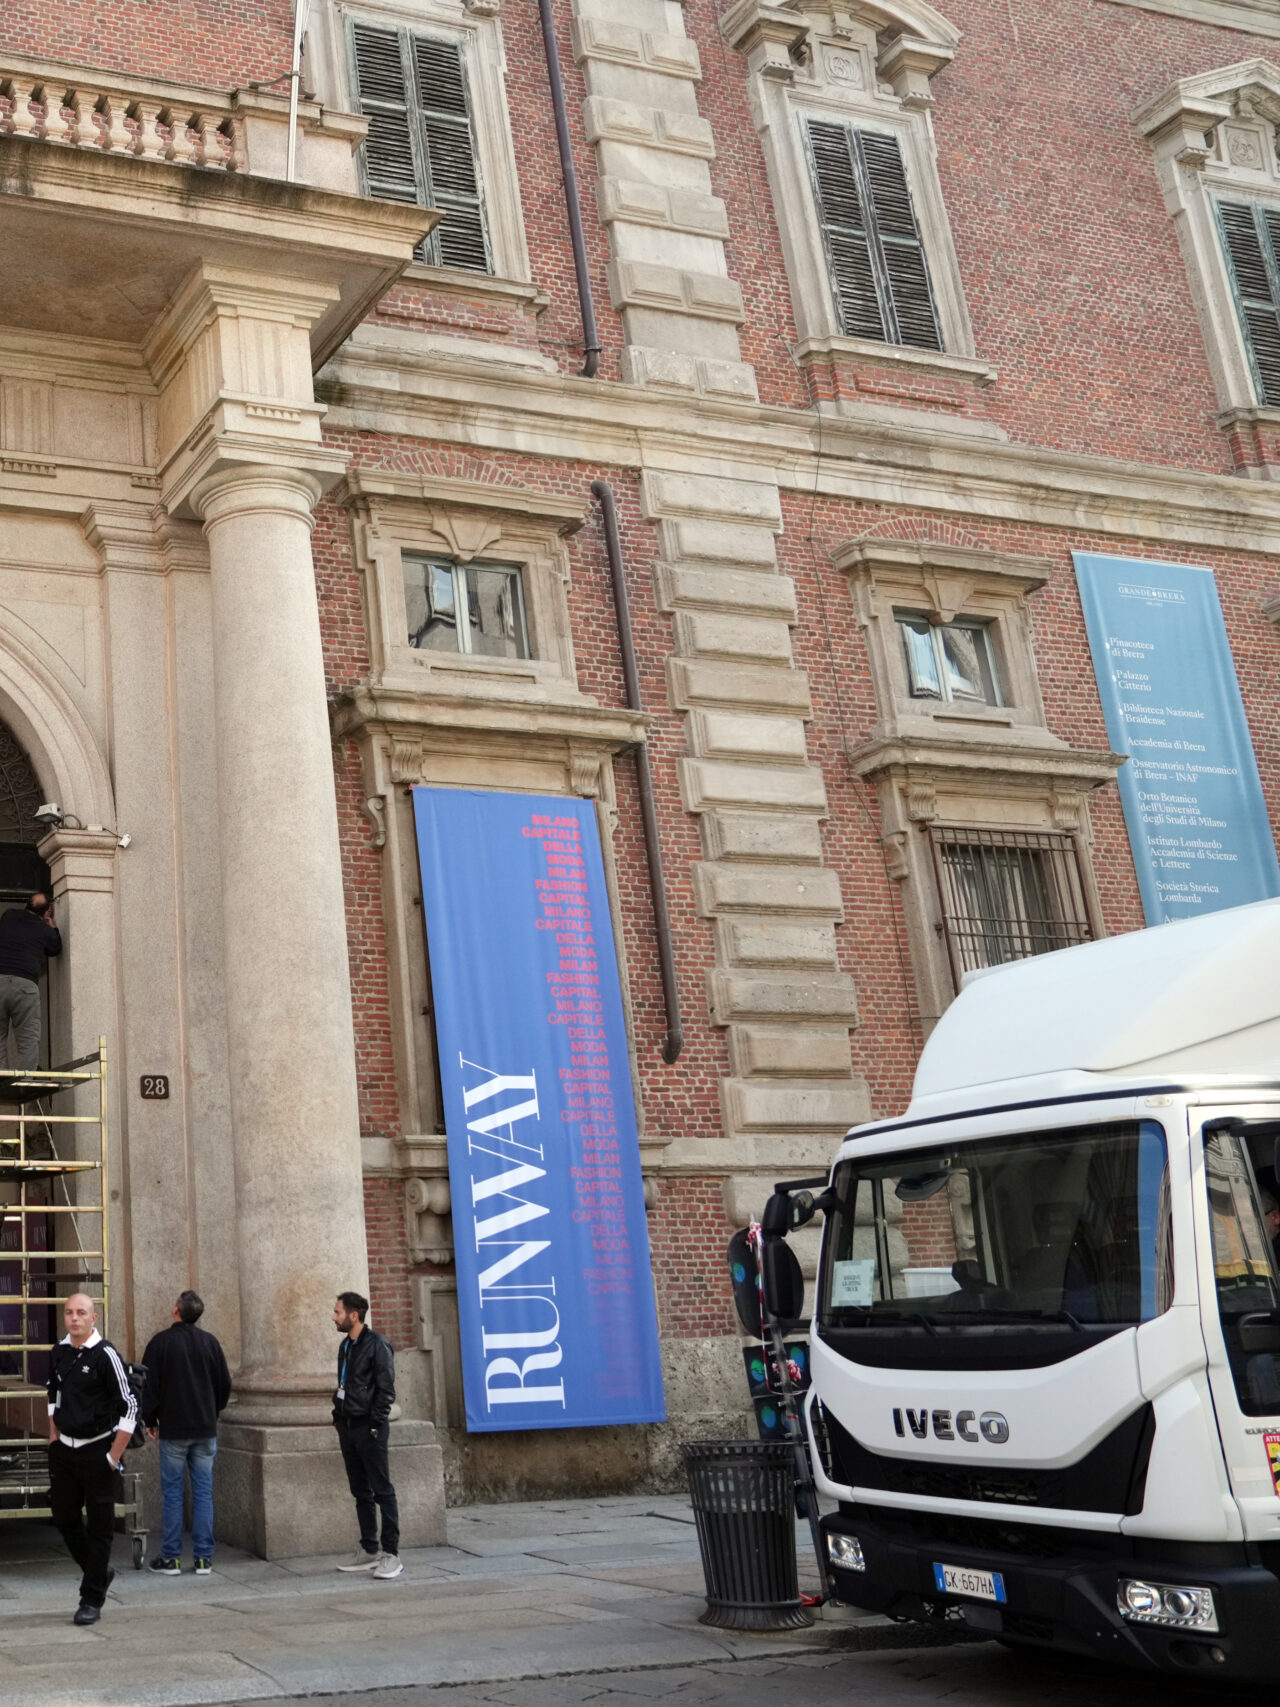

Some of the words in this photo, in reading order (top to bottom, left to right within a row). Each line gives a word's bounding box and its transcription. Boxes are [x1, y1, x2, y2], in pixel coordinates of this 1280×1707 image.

[1110, 637, 1154, 650] Pinacoteca
[1112, 648, 1121, 657] di
[1122, 650, 1145, 659] Brera
[1116, 670, 1148, 680] Palazzo
[1118, 680, 1151, 691] Citterio
[1123, 704, 1164, 715] Biblioteca
[1166, 707, 1205, 719] Nazionale
[1126, 714, 1166, 726] Braidense
[1128, 737, 1173, 749] Accademia
[1174, 740, 1183, 749] di
[1184, 741, 1206, 751] Brera
[1132, 758, 1184, 770] Osservatorio
[1186, 762, 1237, 775] Astronomico
[1134, 770, 1144, 779] di
[1145, 771, 1167, 780] Brera
[1176, 773, 1198, 782] INAF
[1138, 792, 1160, 802] Orto
[1161, 793, 1197, 804] Botanico
[532, 813, 579, 828] MILANO
[1143, 814, 1164, 825] degli
[1166, 816, 1187, 825] Studi
[1189, 817, 1197, 826] di
[1199, 817, 1227, 828] Milano
[521, 826, 581, 841] CAPITALE
[543, 840, 583, 854] DELLA
[1147, 836, 1179, 847] Istituto
[1180, 838, 1222, 849] Lombardo
[547, 853, 584, 866] MODA
[1150, 848, 1196, 859] Accademia
[1197, 850, 1206, 859] di
[1207, 851, 1238, 861] Scienze
[1160, 859, 1191, 869] Lettere
[548, 866, 586, 879] MILAN
[535, 879, 587, 892] FASHION
[1190, 882, 1219, 893] Storica
[539, 892, 590, 906] CAPITAL
[1159, 893, 1201, 903] Lombarda
[544, 905, 591, 919] MILANO
[536, 917, 592, 932] CAPITALE
[556, 932, 595, 945] DELLA
[559, 945, 596, 958] MODA
[560, 959, 598, 971] MILAN
[546, 971, 599, 985] FASHION
[550, 985, 602, 999] CAPITAL
[556, 998, 602, 1012] MILANO
[548, 1011, 604, 1026] CAPITALE
[568, 1026, 607, 1040] DELLA
[571, 1040, 608, 1053] MODA
[571, 1054, 609, 1067] MILAN
[558, 1067, 611, 1080] FASHION
[144, 1078, 166, 1095] 28
[564, 1081, 612, 1094] CAPITAL
[569, 1095, 614, 1108] MILANO
[561, 1108, 615, 1123] CAPITALE
[580, 1123, 618, 1137] DELLA
[582, 1137, 619, 1151] MODA
[583, 1152, 620, 1165] MILAN
[571, 1165, 621, 1179] FASHION
[576, 1179, 623, 1193] CAPITAL
[580, 1194, 624, 1207] MILANO
[572, 1207, 624, 1222] CAPITALE
[459, 1051, 566, 1413] RUNWAY
[590, 1223, 628, 1237] DELLA
[892, 1408, 1010, 1444] IVECO
[961, 1573, 996, 1596] 667HA
